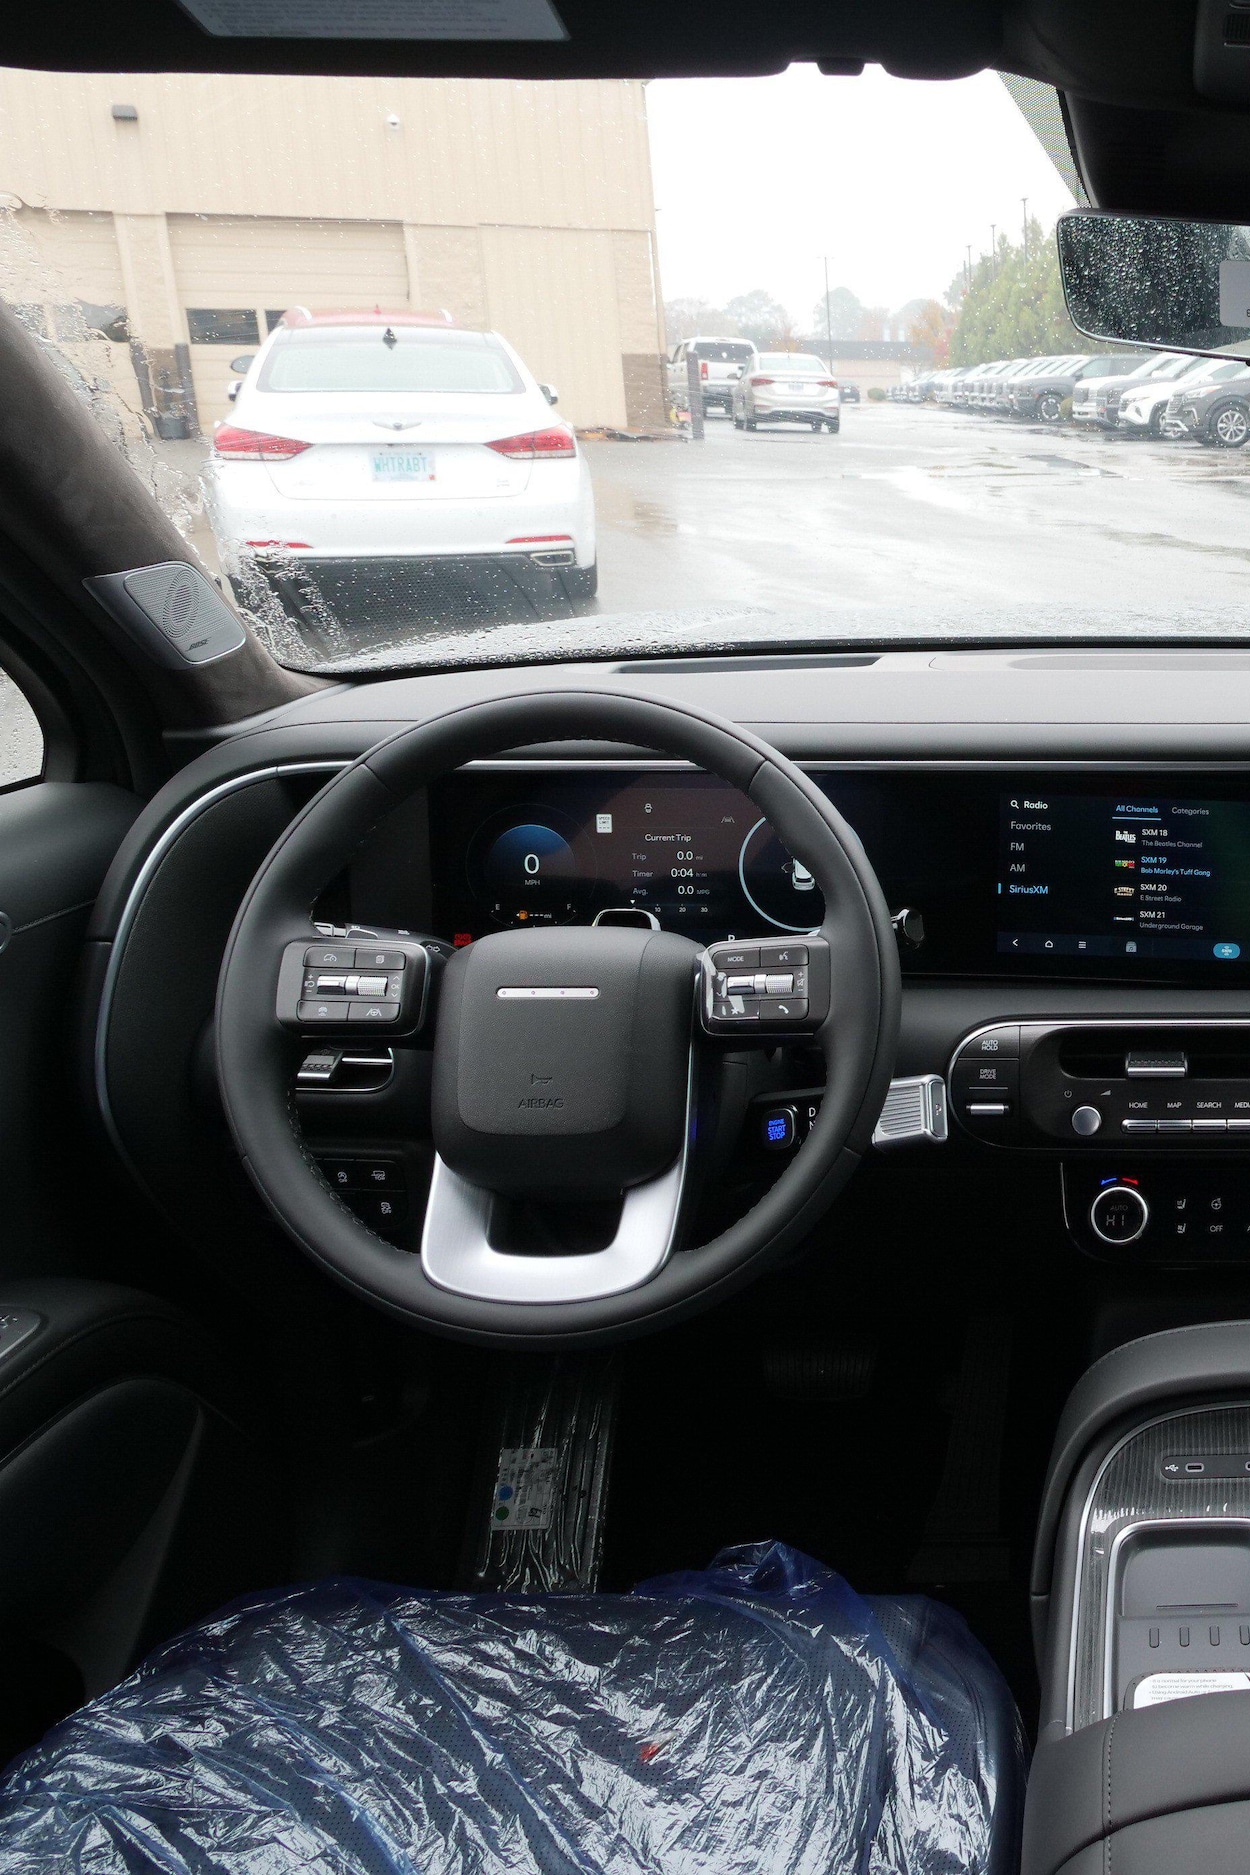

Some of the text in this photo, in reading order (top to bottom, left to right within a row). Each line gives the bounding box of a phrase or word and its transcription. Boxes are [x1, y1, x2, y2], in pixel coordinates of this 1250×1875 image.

[373, 456, 427, 472] WHTRABT
[1023, 800, 1049, 810] Radio
[1115, 804, 1159, 814] All Channels
[1171, 806, 1210, 816] Categories
[1010, 820, 1052, 831] Favorites
[644, 833, 692, 842] Current Trip
[1141, 828, 1168, 837] SXM 18
[1010, 842, 1025, 851] FM
[631, 852, 647, 861] Trip
[676, 850, 694, 860] 0.0
[1140, 856, 1158, 864] SXM
[1158, 856, 1167, 864] 19
[524, 853, 540, 874] 0
[1009, 863, 1026, 872] AM
[632, 869, 654, 877] Timer
[670, 867, 694, 878] 0:04
[1154, 867, 1179, 876] Marley's
[1180, 868, 1193, 876] Tuff
[1193, 869, 1211, 877] Gang
[632, 887, 649, 896] Avg.
[677, 885, 695, 895] 0.0
[1009, 884, 1049, 895] SiriusXM
[1140, 883, 1167, 892] SXM 20
[495, 903, 501, 911] E
[1139, 910, 1166, 919] SXM 21
[1139, 922, 1204, 931] Underground Garage
[517, 1098, 565, 1109] AIRBAG
[1196, 1101, 1222, 1109] SEARCH
[768, 1124, 787, 1134] START
[769, 1131, 786, 1141] STOP
[1109, 1204, 1129, 1212] AUTO
[1209, 1224, 1224, 1233] OFF
